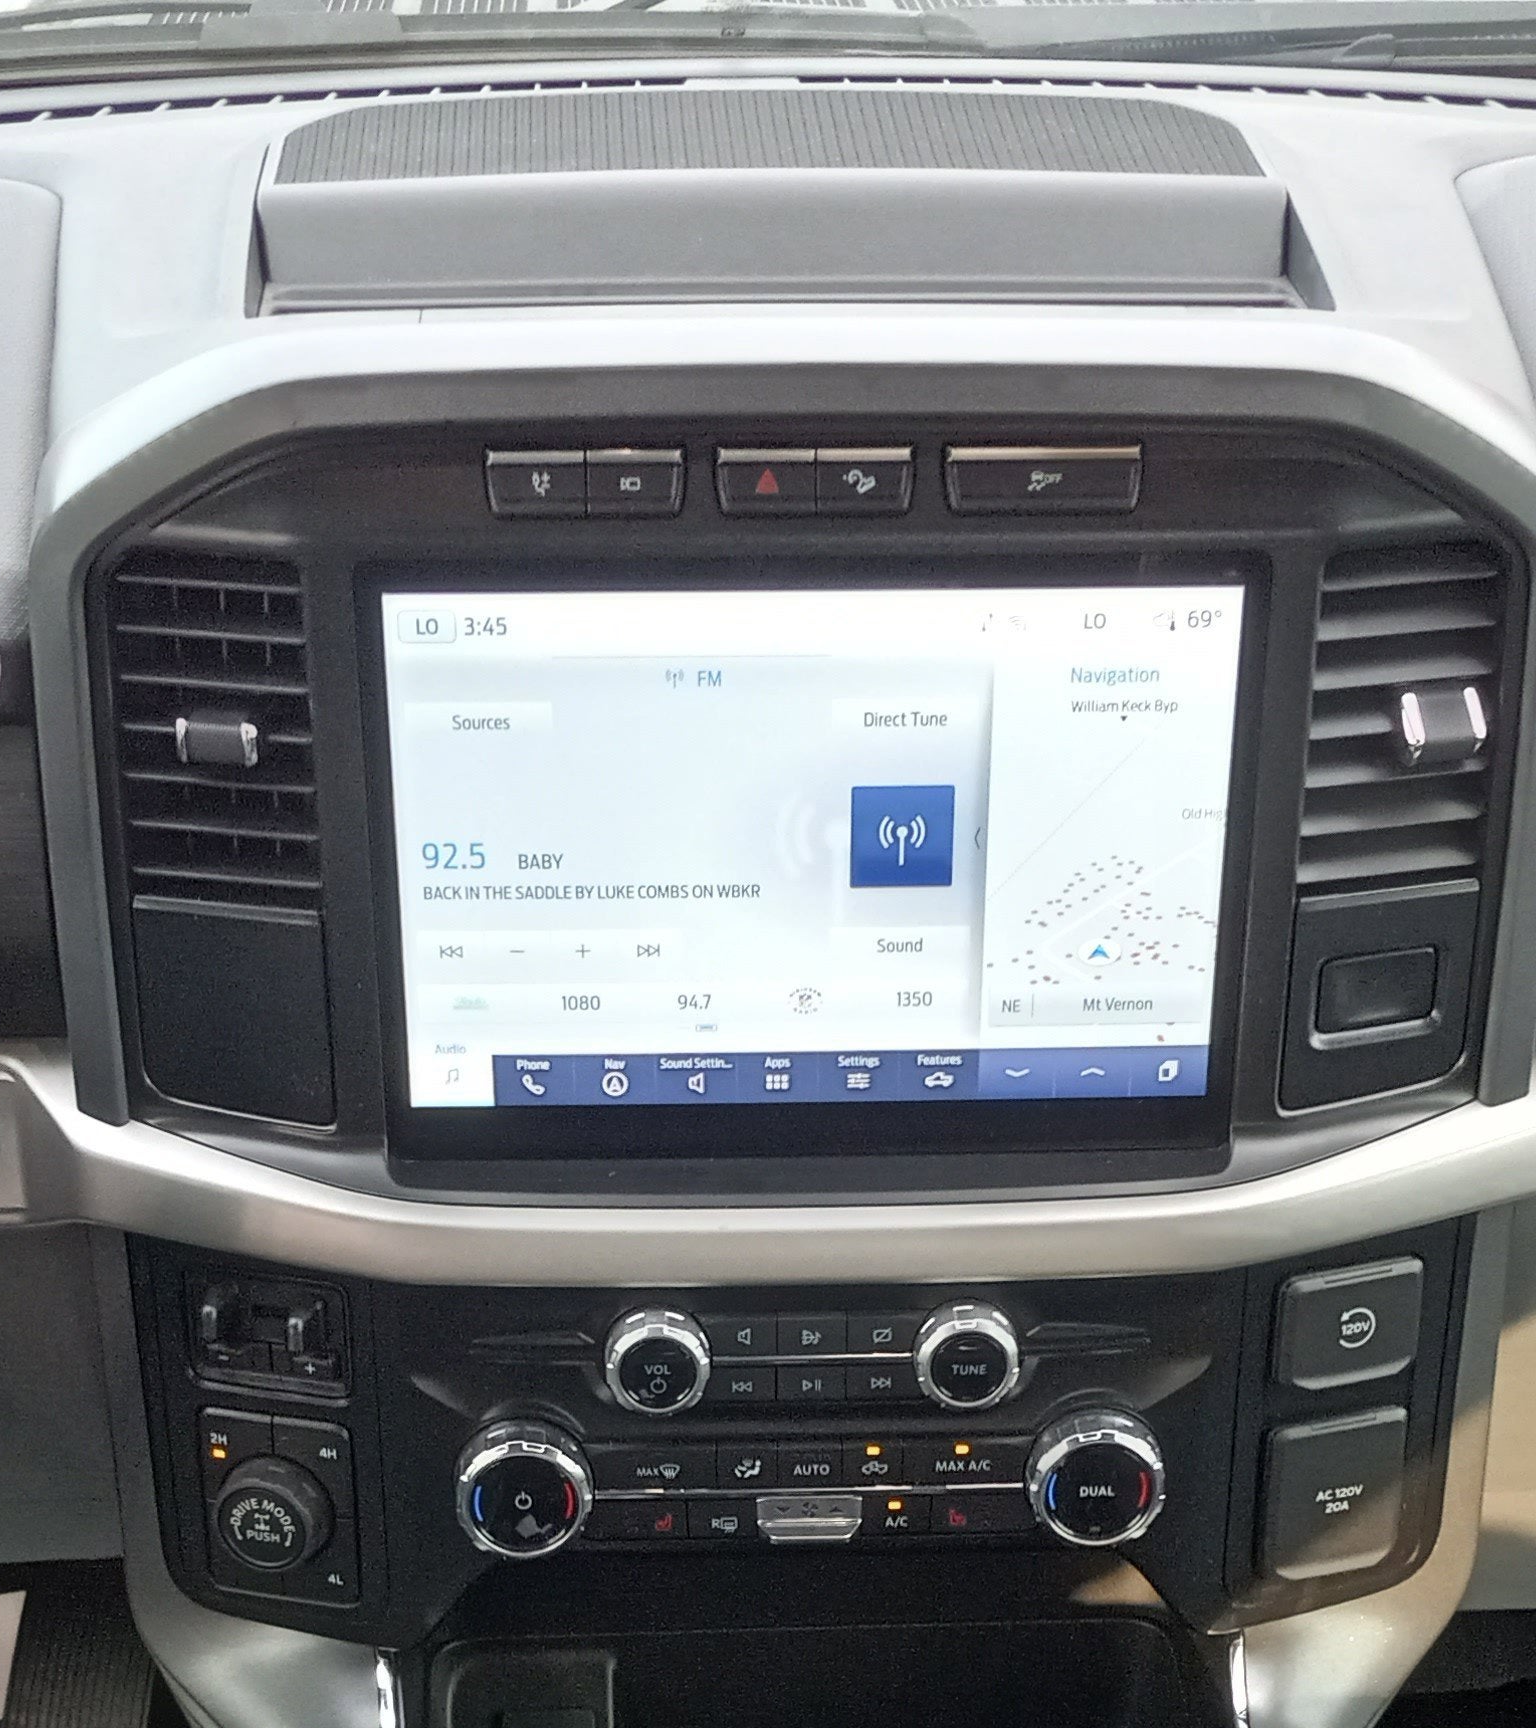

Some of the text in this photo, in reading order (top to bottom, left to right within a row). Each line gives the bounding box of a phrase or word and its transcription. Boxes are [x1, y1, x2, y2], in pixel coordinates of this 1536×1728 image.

[416, 618, 439, 635] LO
[464, 617, 507, 636] 3:45
[1084, 613, 1107, 630] LO
[1186, 610, 1223, 629] 69°
[697, 671, 722, 688] FM
[1070, 667, 1160, 686] Navigation
[1071, 700, 1179, 714] William Keck Byp
[452, 715, 511, 731] Sources
[864, 711, 948, 728] Direct Tune
[422, 843, 486, 870] 92.5
[518, 853, 563, 870] BABY
[423, 885, 761, 900] BACK IN THE SADDLE BY LUKE COMBS ON WBKR
[876, 938, 924, 954] Sound
[562, 995, 601, 1011] 1080
[678, 994, 711, 1011] 94.7
[896, 991, 933, 1007] 1350
[1001, 999, 1021, 1014] NE
[1082, 997, 1153, 1012] Mt Vernon
[435, 1043, 467, 1055] Audio
[516, 1059, 550, 1071] Phone
[604, 1058, 625, 1069] Nav
[660, 1057, 692, 1069] Sound
[764, 1057, 790, 1070] Apps
[837, 1055, 880, 1068] Settings
[917, 1054, 962, 1067] Features
[1342, 1321, 1370, 1336] 120V
[644, 1364, 672, 1376] VOL
[951, 1363, 988, 1376] TUNE
[210, 1433, 228, 1446] 2H
[319, 1447, 337, 1460] 4H
[636, 1466, 660, 1477] MAX
[793, 1464, 830, 1477] AUTO
[935, 1459, 992, 1473] MAX A/C
[1079, 1485, 1115, 1498] DUAL
[1315, 1484, 1364, 1503] AC 120V
[1324, 1500, 1350, 1514] 20A
[229, 1497, 296, 1534] DRIVE MODE
[884, 1515, 908, 1529] A/C
[246, 1529, 281, 1544] PUSH
[328, 1573, 344, 1586] 4L
